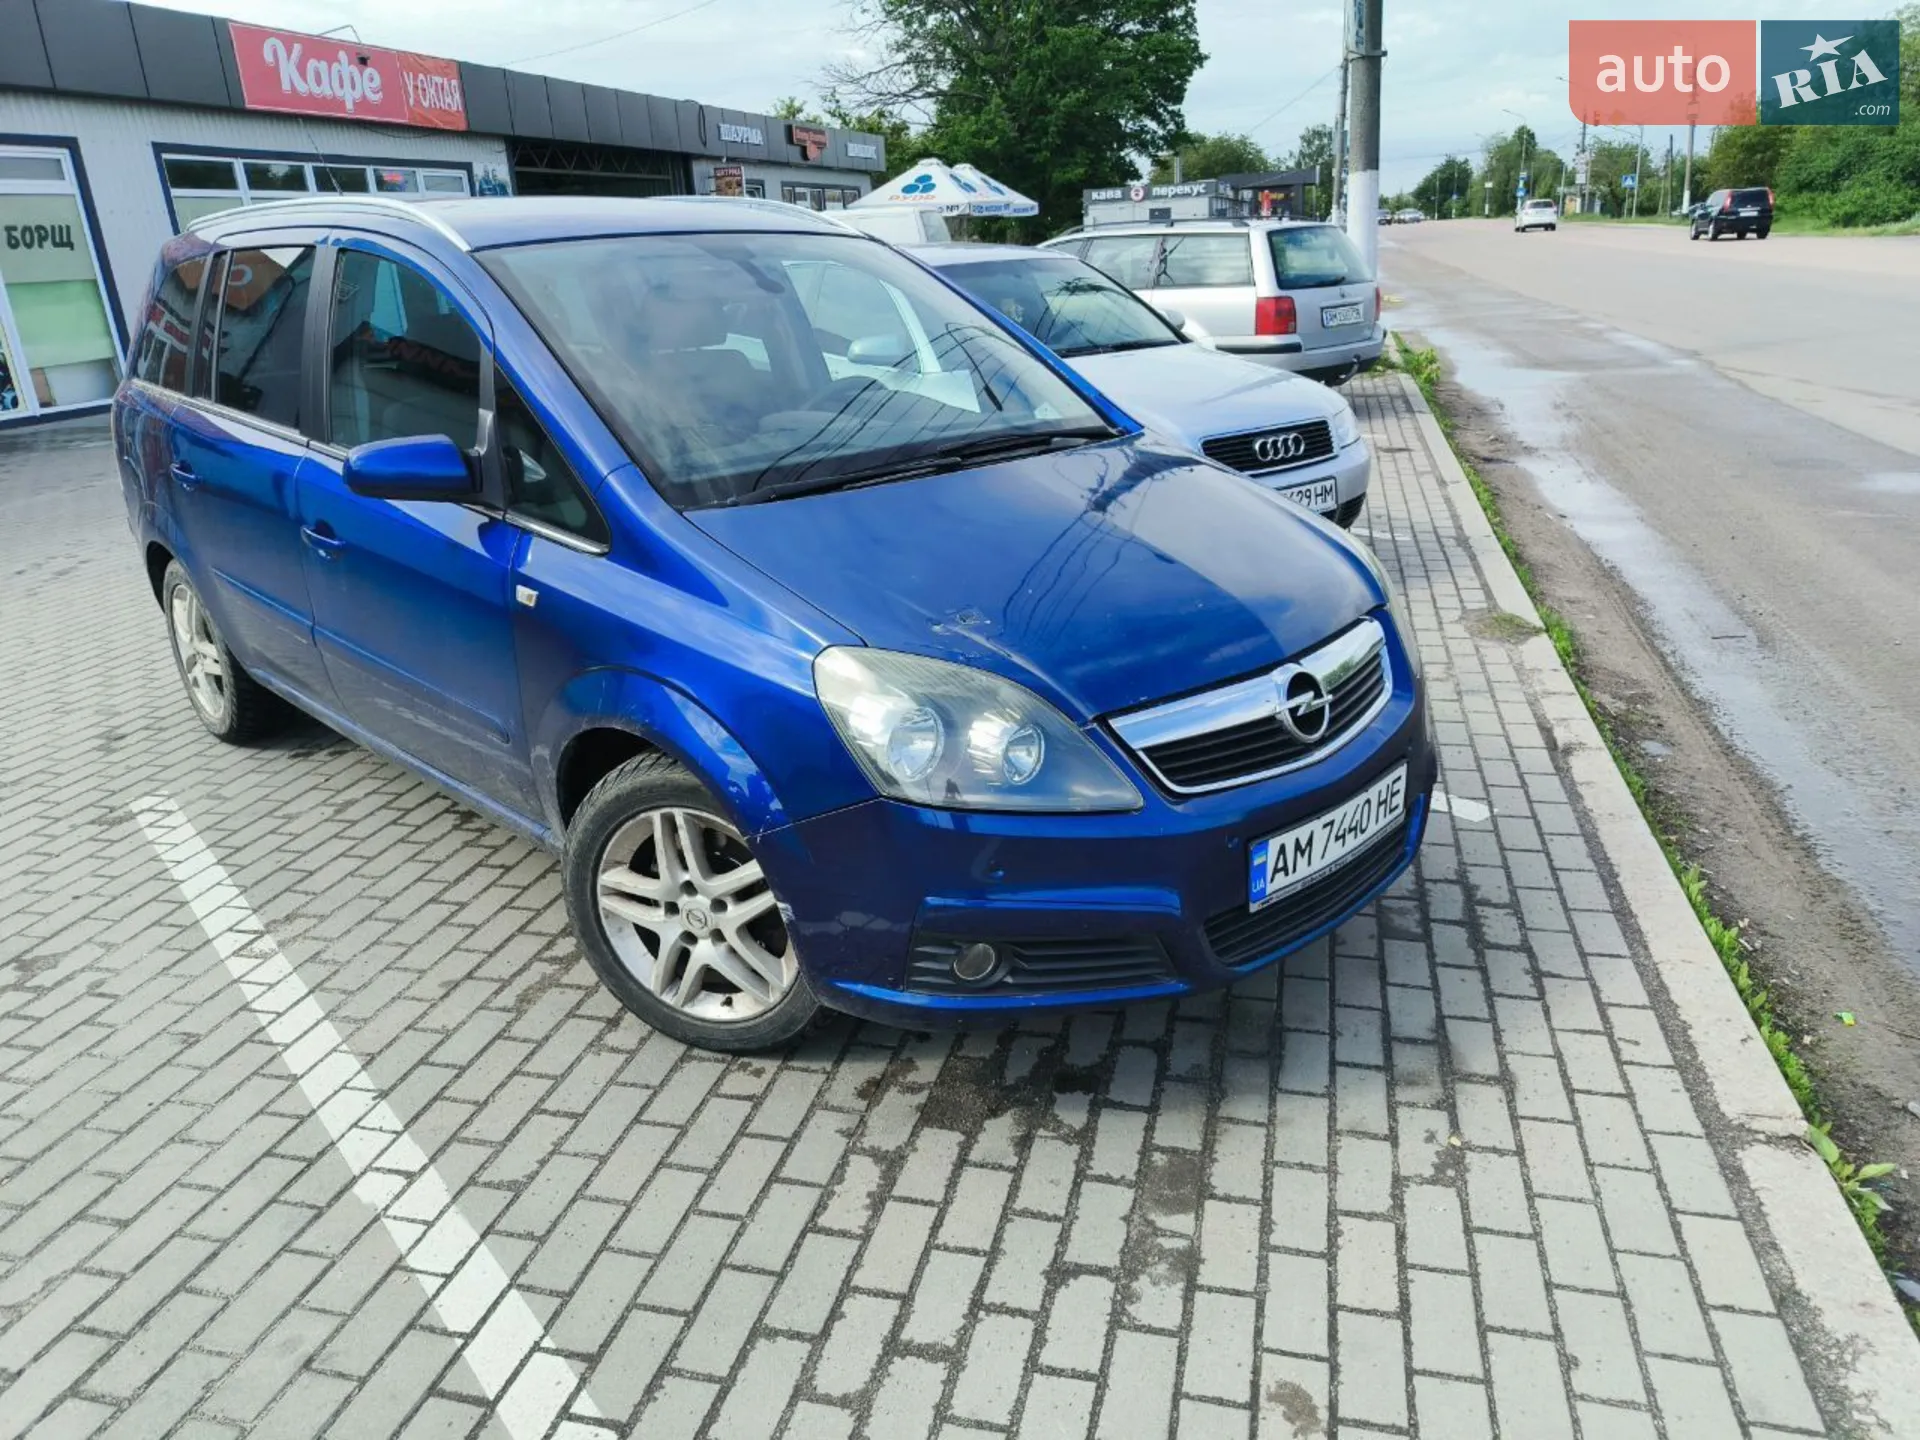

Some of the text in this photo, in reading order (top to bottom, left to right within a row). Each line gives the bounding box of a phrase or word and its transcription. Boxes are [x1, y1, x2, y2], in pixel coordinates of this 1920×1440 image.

[263, 37, 383, 114] Кафе
[403, 71, 415, 108] У
[1091, 189, 1123, 201] кава
[1152, 182, 1206, 199] перекус
[4, 224, 75, 251] БОРЩ
[1314, 483, 1334, 506] HM
[1270, 830, 1314, 884] AM
[1321, 797, 1372, 860] 7440
[1375, 775, 1402, 824] HE
